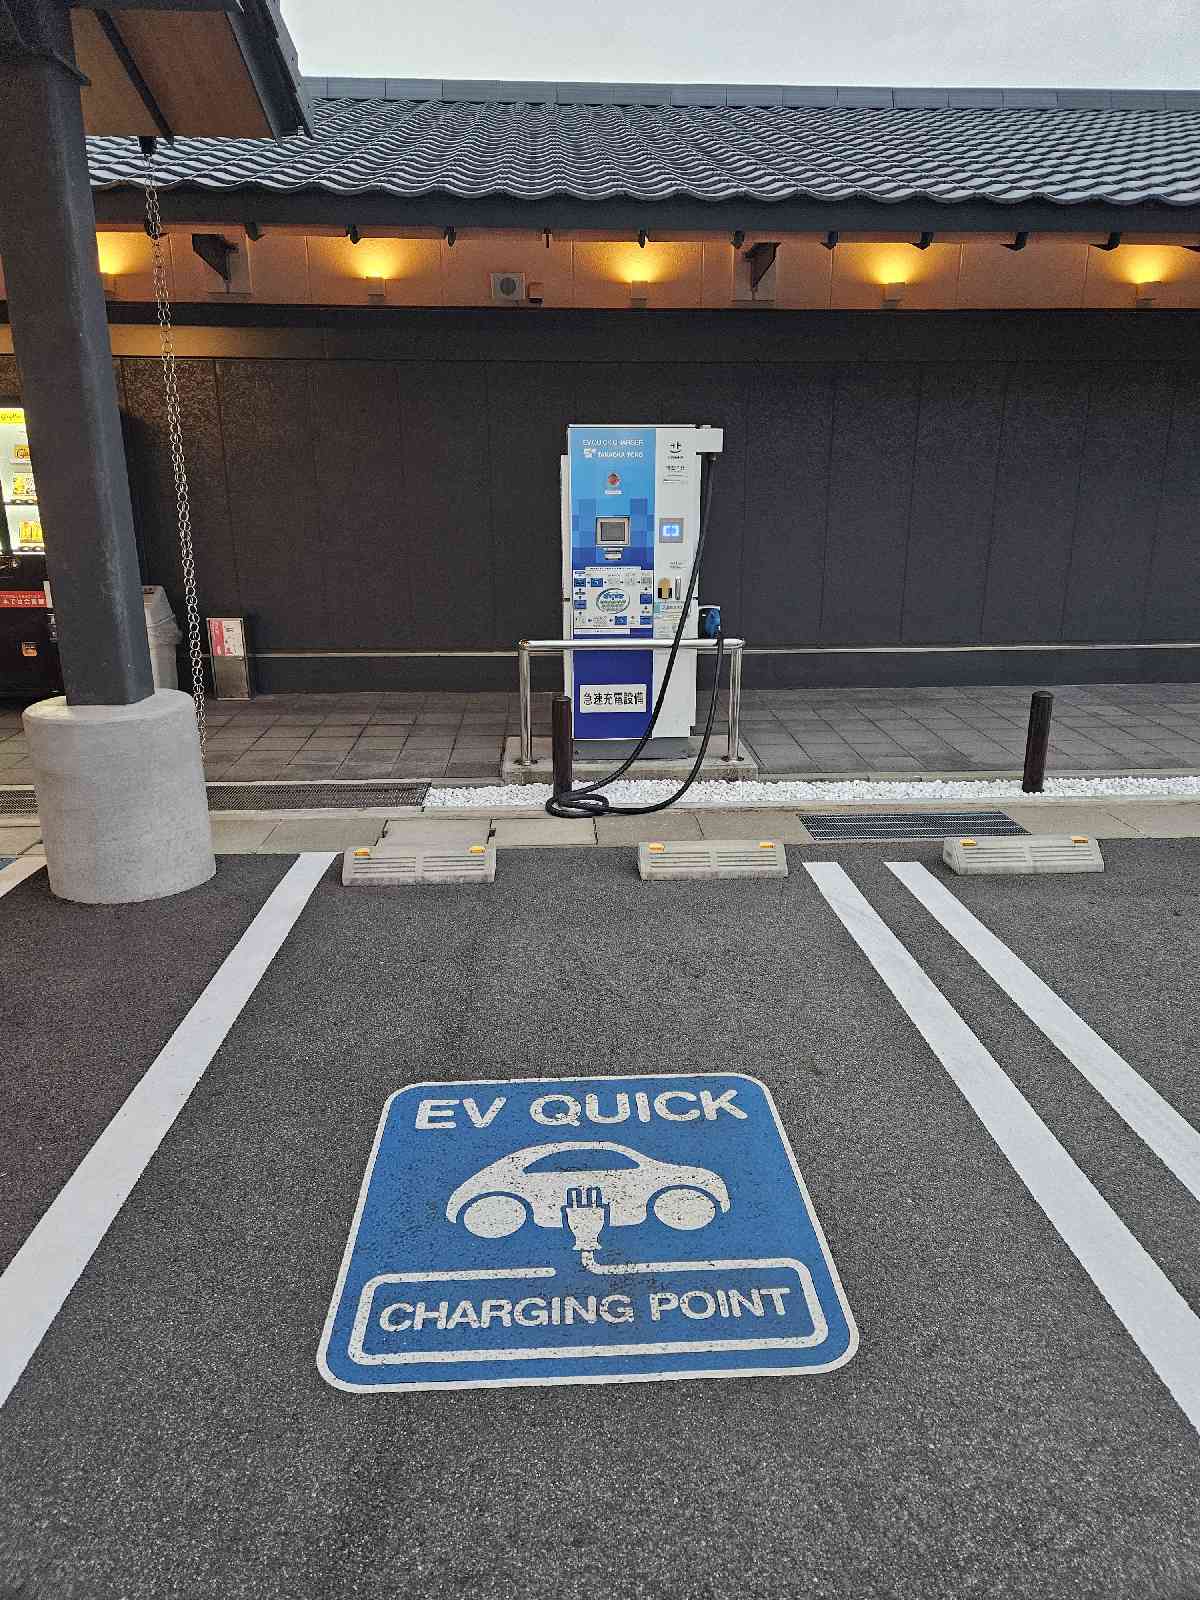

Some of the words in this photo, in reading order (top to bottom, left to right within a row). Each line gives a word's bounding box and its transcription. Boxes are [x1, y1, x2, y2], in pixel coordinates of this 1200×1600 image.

[583, 692, 643, 705] 急速充電設備
[415, 1097, 505, 1129] EV
[529, 1089, 748, 1126] QUICK
[379, 1295, 635, 1332] CHARGING
[650, 1287, 791, 1321] POINT
